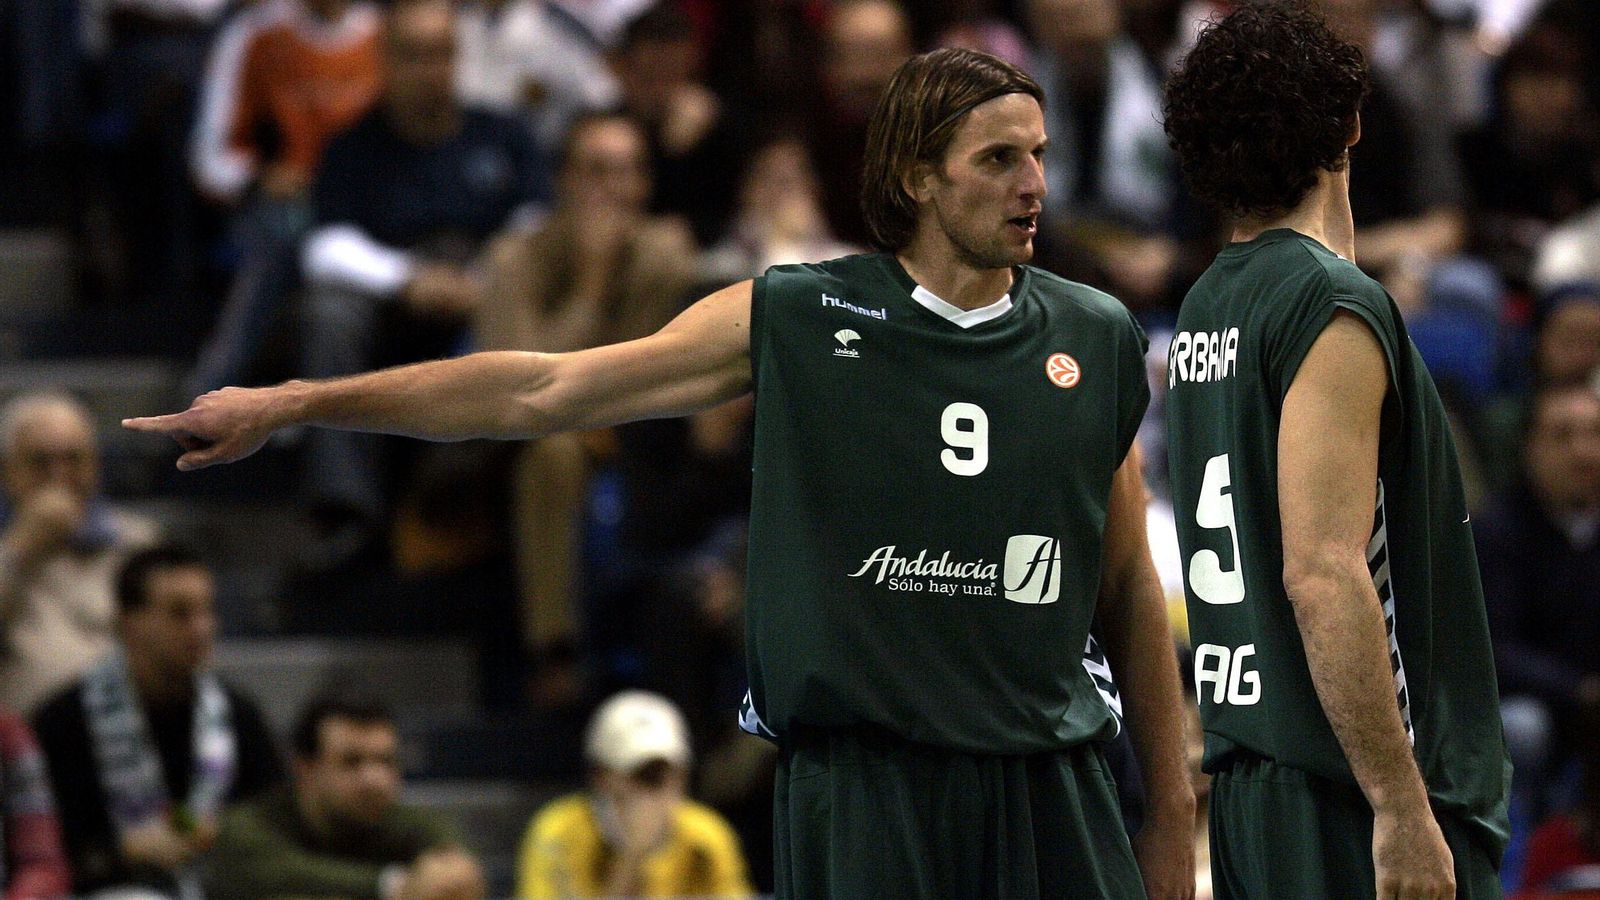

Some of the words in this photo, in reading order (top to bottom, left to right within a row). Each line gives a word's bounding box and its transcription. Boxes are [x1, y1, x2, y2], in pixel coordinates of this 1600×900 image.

[822, 293, 887, 320] hummel
[834, 348, 859, 357] Unicaja
[940, 402, 989, 477] 9
[1188, 453, 1246, 605] 5
[888, 578, 923, 592] Sólo
[928, 580, 958, 596] hay
